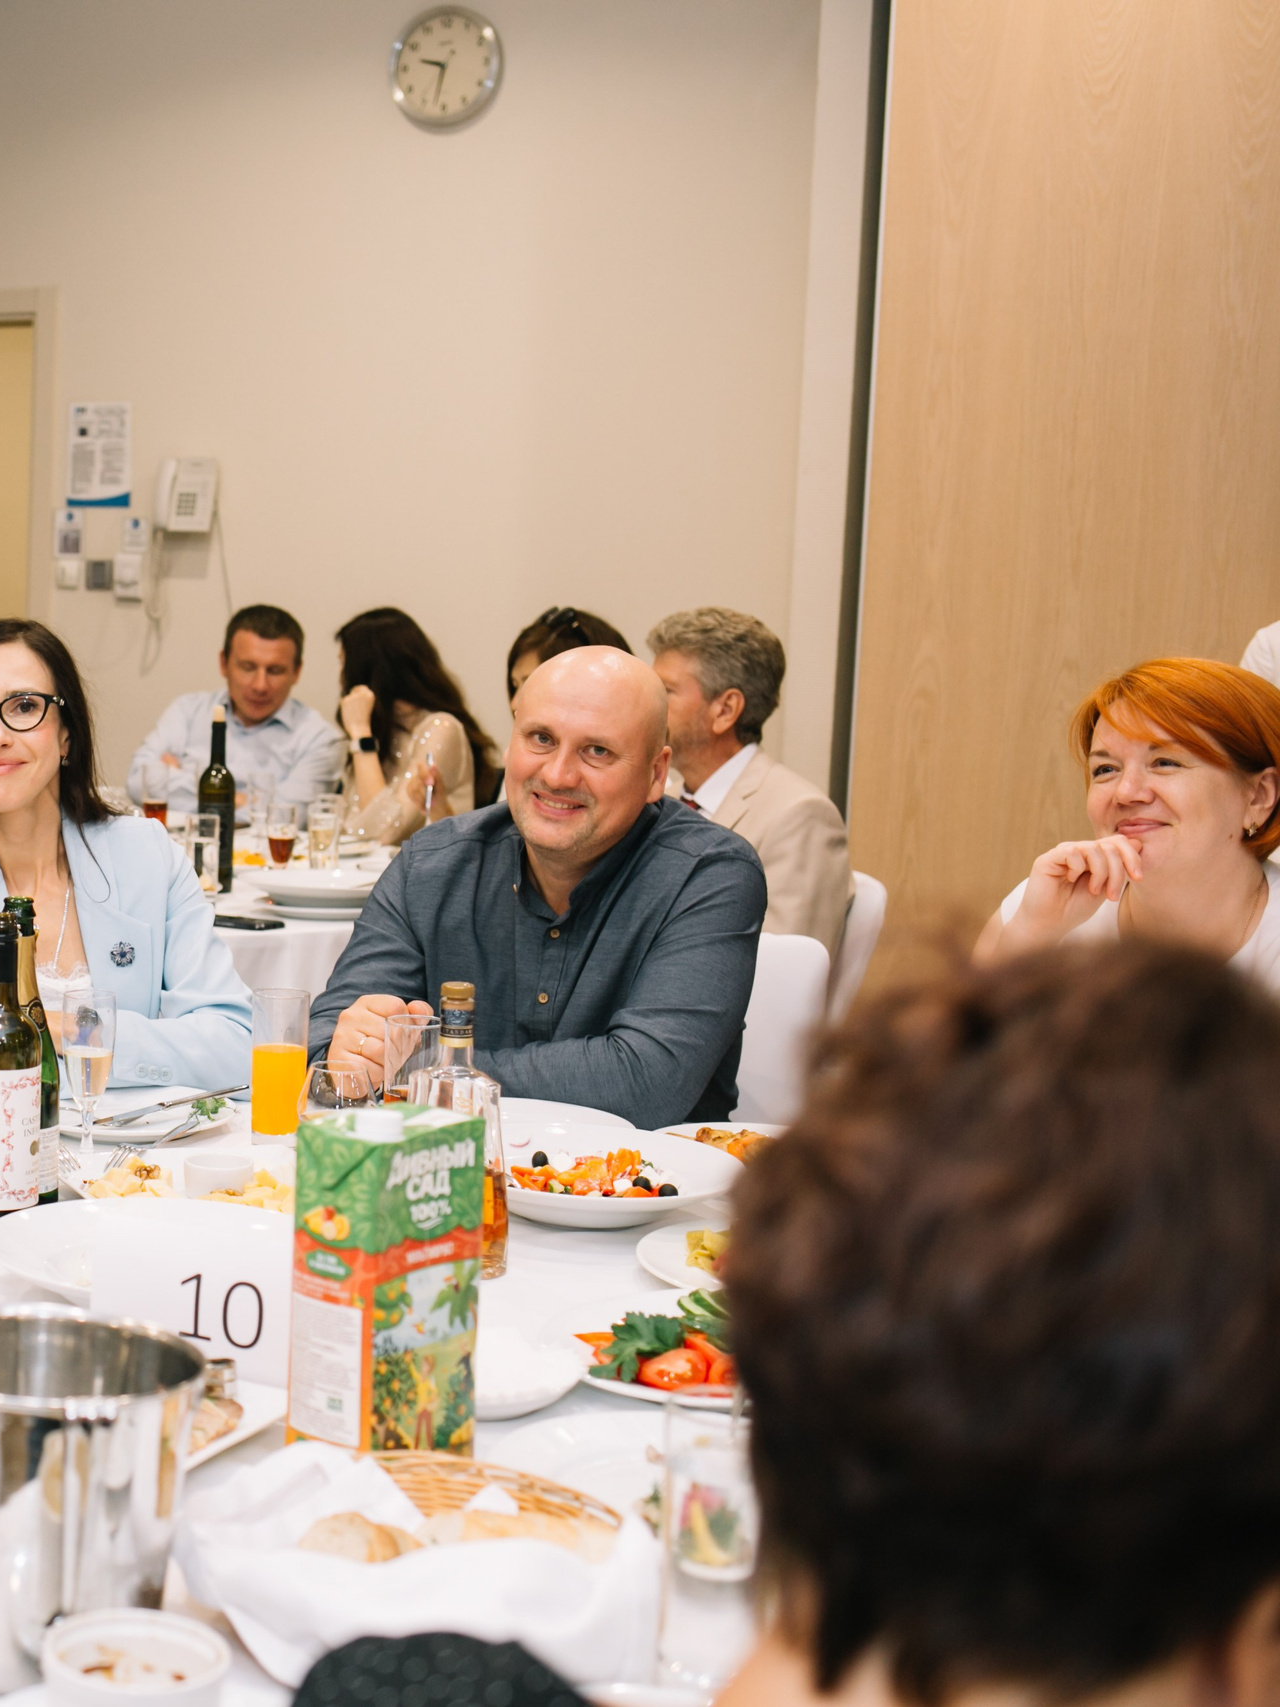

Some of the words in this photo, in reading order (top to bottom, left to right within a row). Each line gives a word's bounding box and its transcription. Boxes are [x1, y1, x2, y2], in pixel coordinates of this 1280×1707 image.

[385, 1137, 476, 1191] ДИВНЫЙ
[405, 1170, 452, 1201] САД
[409, 1199, 452, 1222] 100%
[178, 1273, 264, 1349] 10
